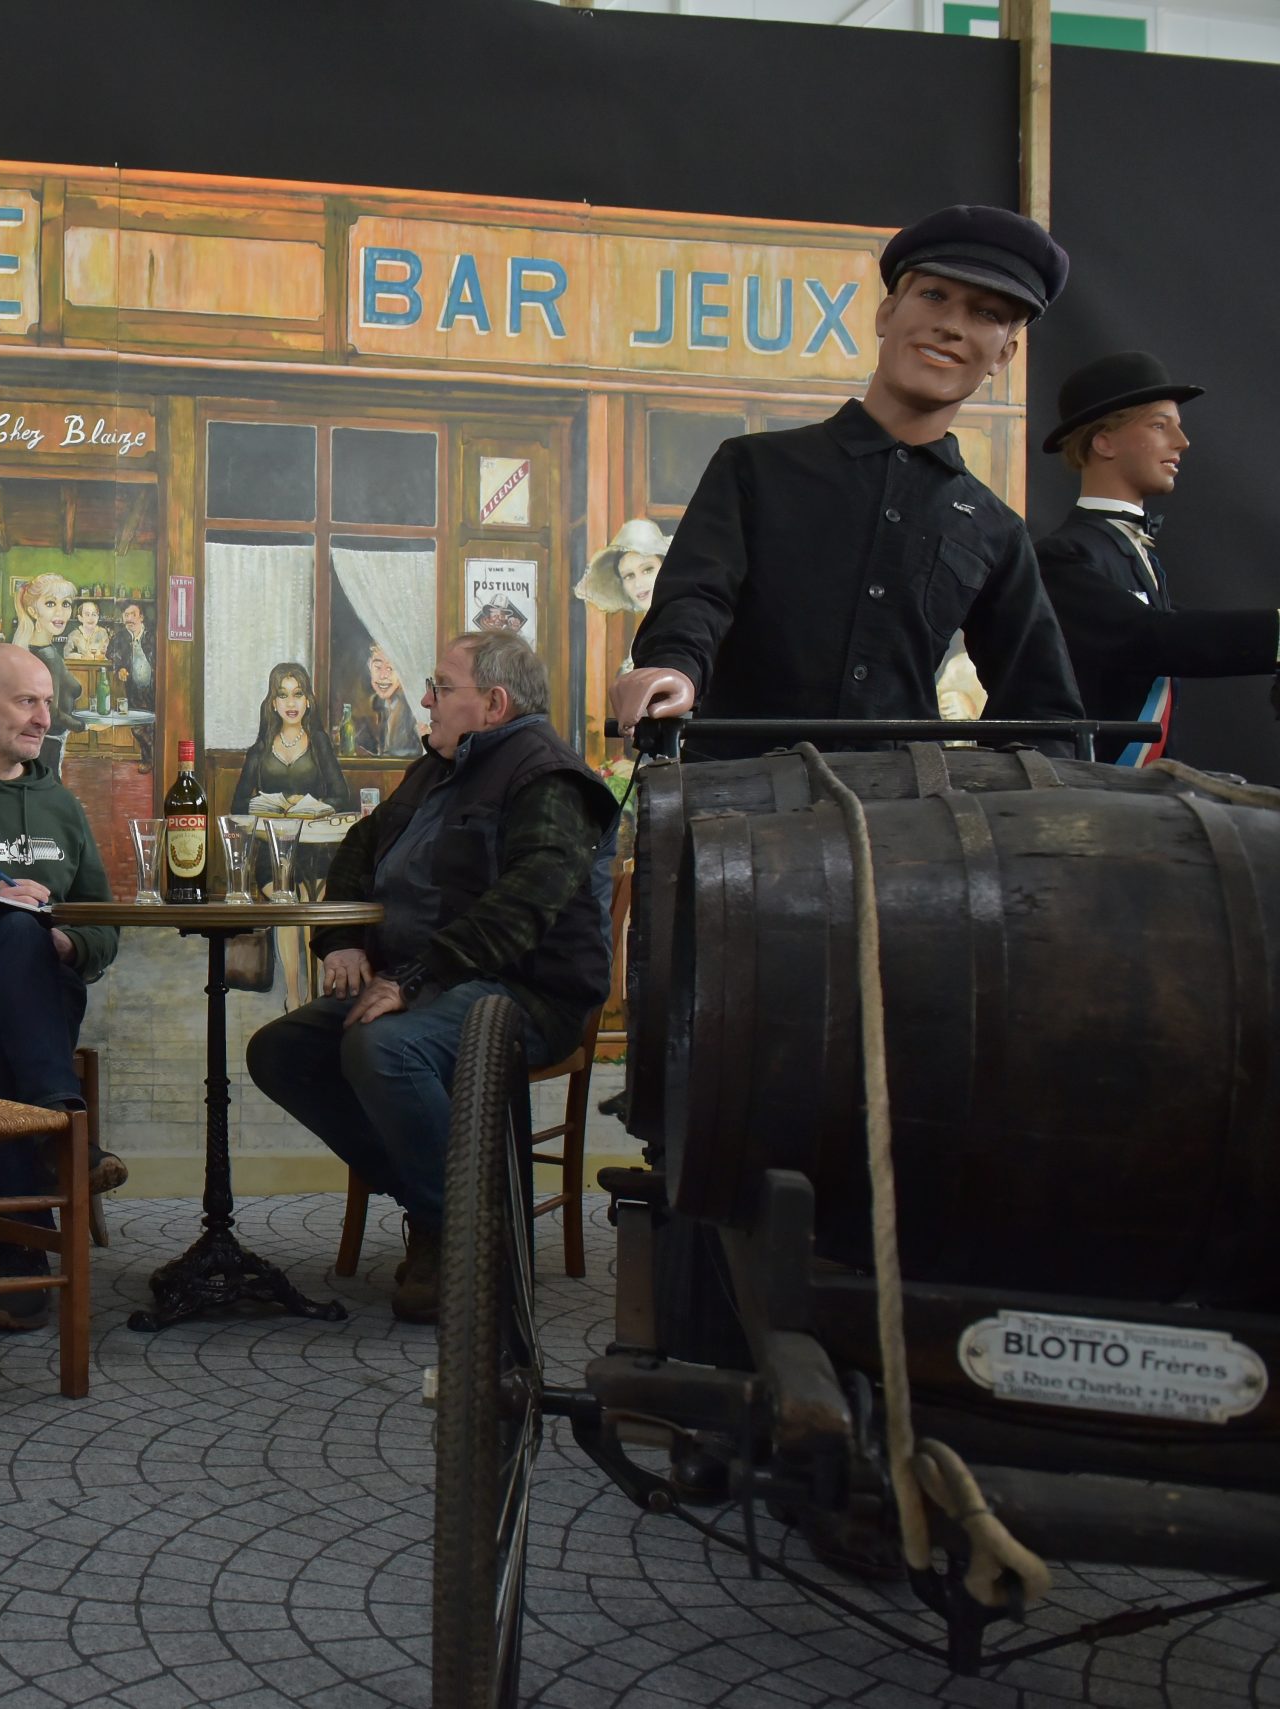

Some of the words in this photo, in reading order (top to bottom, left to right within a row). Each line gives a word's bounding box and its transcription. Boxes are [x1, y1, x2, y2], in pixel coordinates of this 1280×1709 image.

[358, 245, 567, 340] BAR
[629, 268, 859, 358] JEUX
[58, 413, 148, 456] Blaize
[483, 467, 525, 519] LICENCE
[473, 580, 530, 599] POSTILLON
[168, 817, 205, 827] PICON
[1004, 1332, 1129, 1367] BLOTTO
[1141, 1350, 1228, 1380] Frères
[1023, 1371, 1062, 1389] Rue
[1068, 1377, 1142, 1398] Charlot
[1164, 1387, 1221, 1407] Paris
